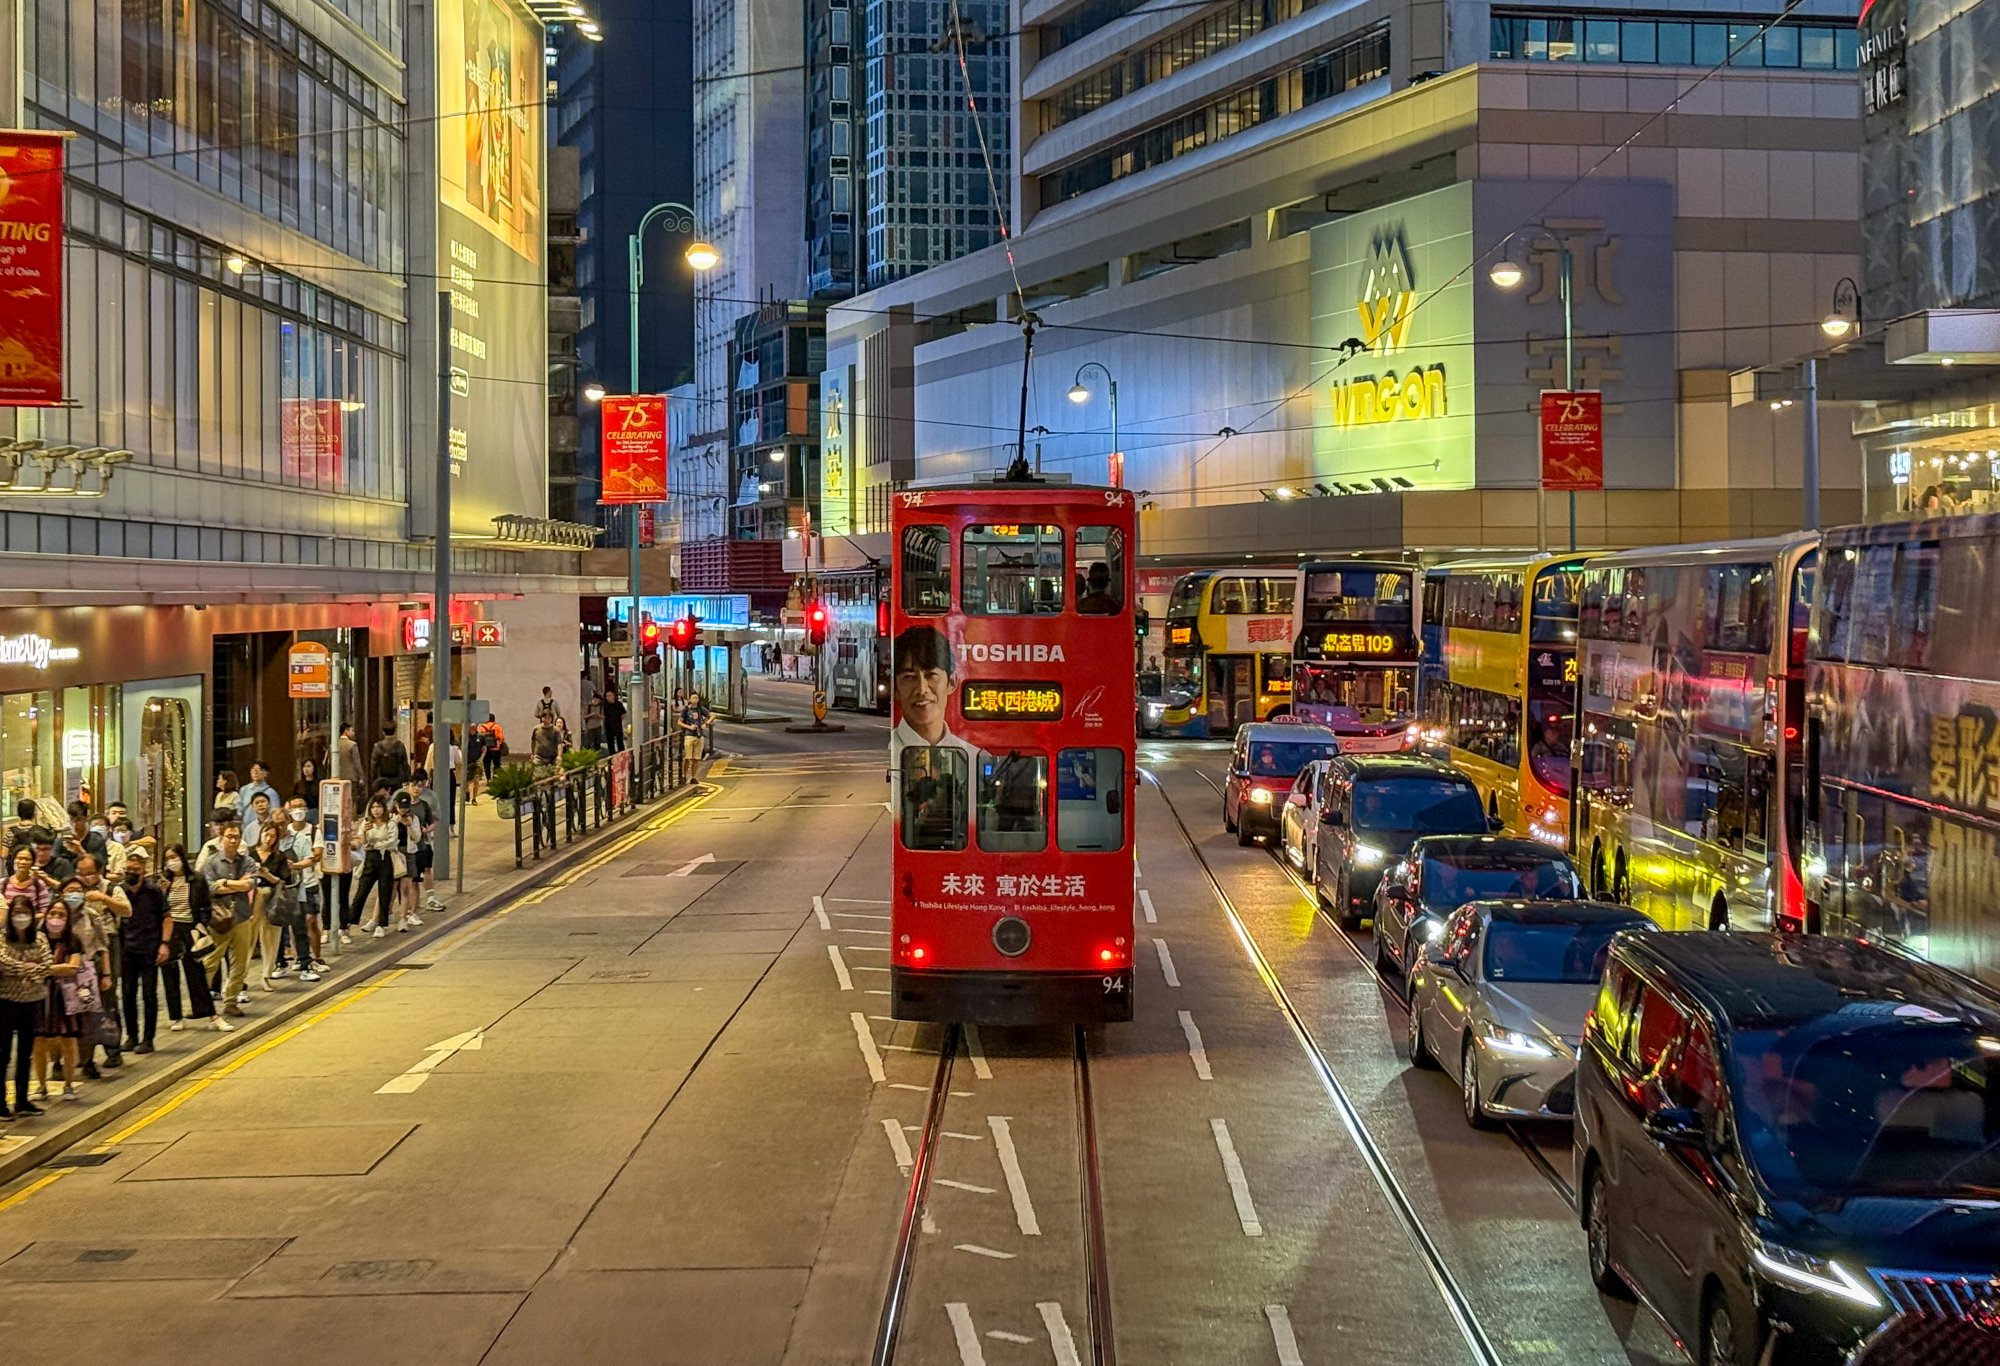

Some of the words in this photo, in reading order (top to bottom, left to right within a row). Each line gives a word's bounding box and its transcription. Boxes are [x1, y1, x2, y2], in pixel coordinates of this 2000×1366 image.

[618, 402, 650, 431] 75
[1556, 397, 1586, 423] 75
[606, 431, 662, 440] CELEBRATING
[1545, 424, 1598, 432] CELEBRATING
[902, 492, 924, 508] 94
[1104, 491, 1125, 508] 94
[957, 643, 1065, 663] TOSHIBA
[1366, 635, 1394, 653] 109
[964, 688, 1062, 713] 上環(西港城)
[941, 872, 986, 898] 未來
[995, 873, 1086, 898] 寓於生活
[919, 901, 943, 910] Toshiba
[943, 902, 969, 912] Lifestyle
[969, 904, 988, 913] Hong
[988, 904, 1006, 913] Kong
[1103, 976, 1124, 995] 94
